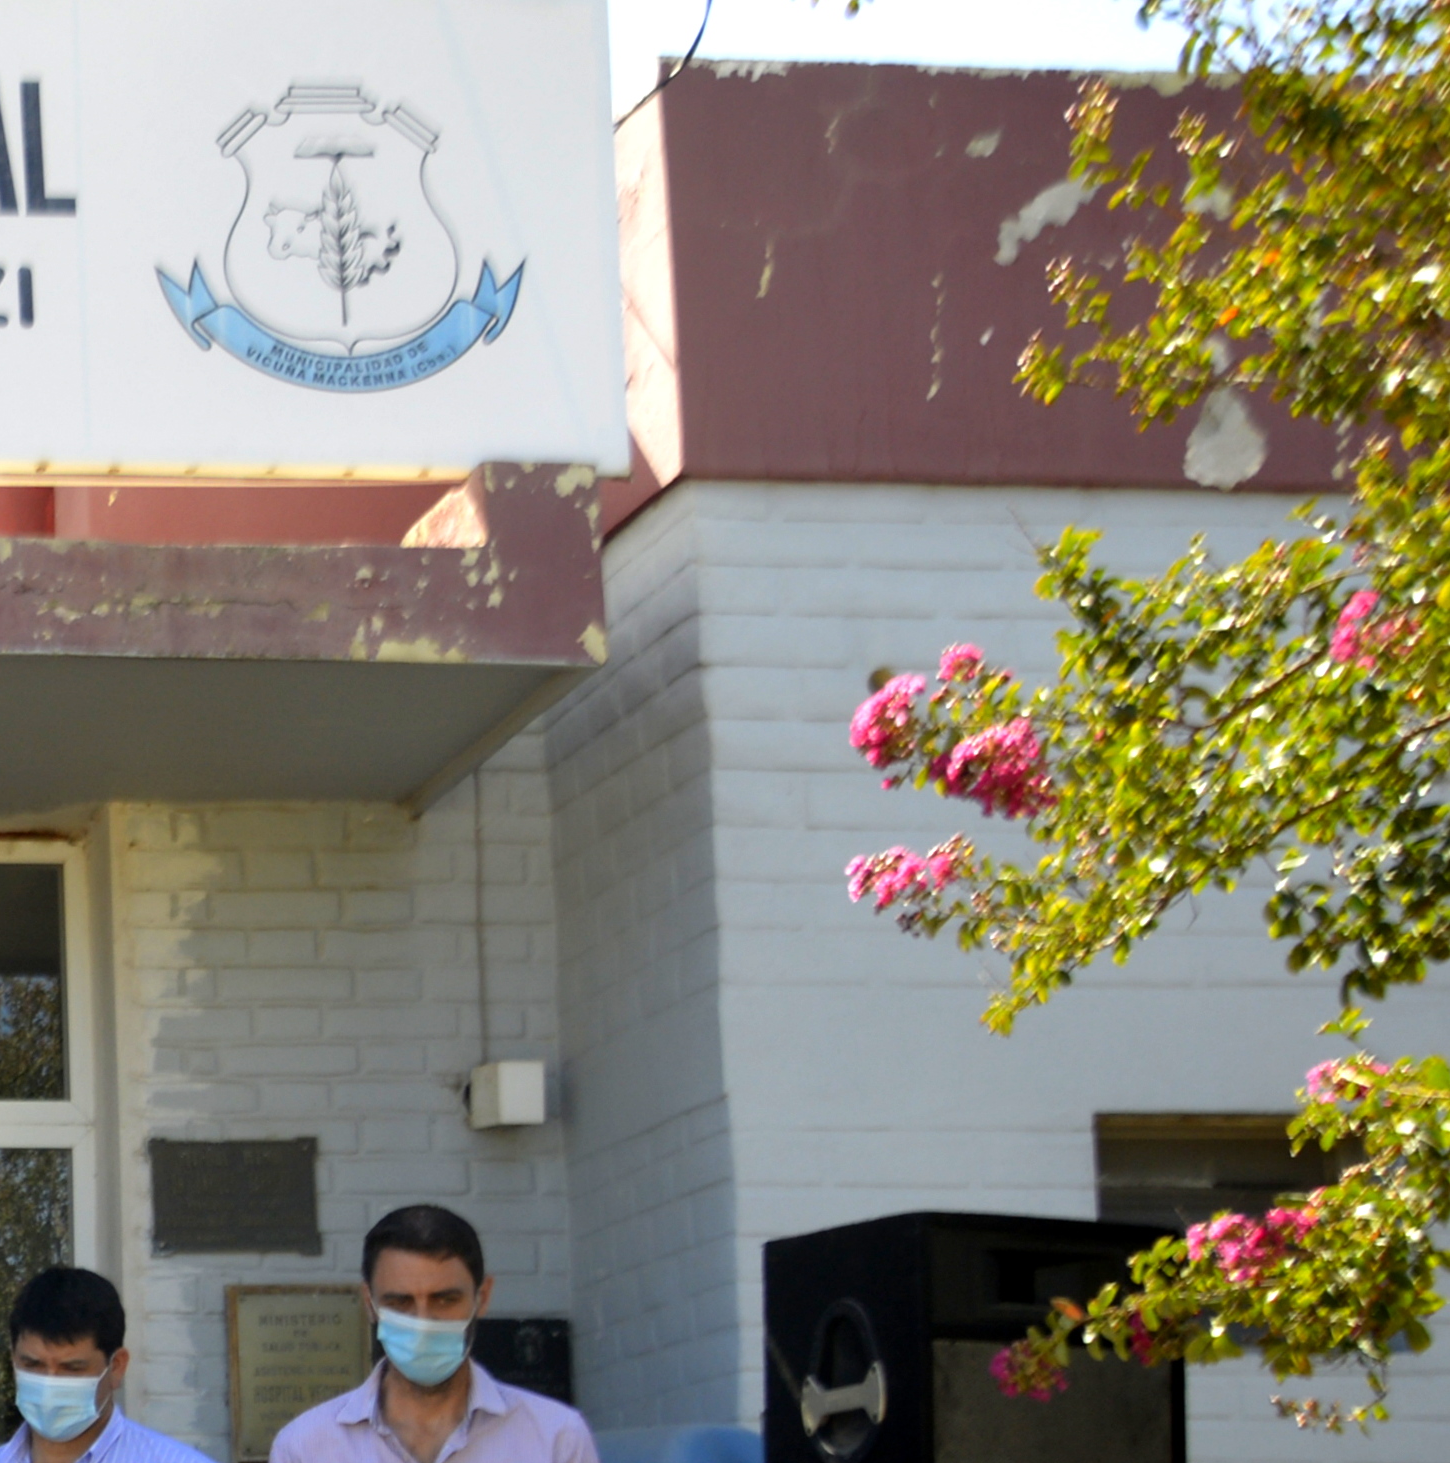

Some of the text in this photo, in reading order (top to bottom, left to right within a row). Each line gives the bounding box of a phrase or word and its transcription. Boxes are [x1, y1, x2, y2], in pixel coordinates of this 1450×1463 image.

[270, 341, 430, 374] MUNICIPALIDAD DE
[312, 370, 407, 388] MACKENNA
